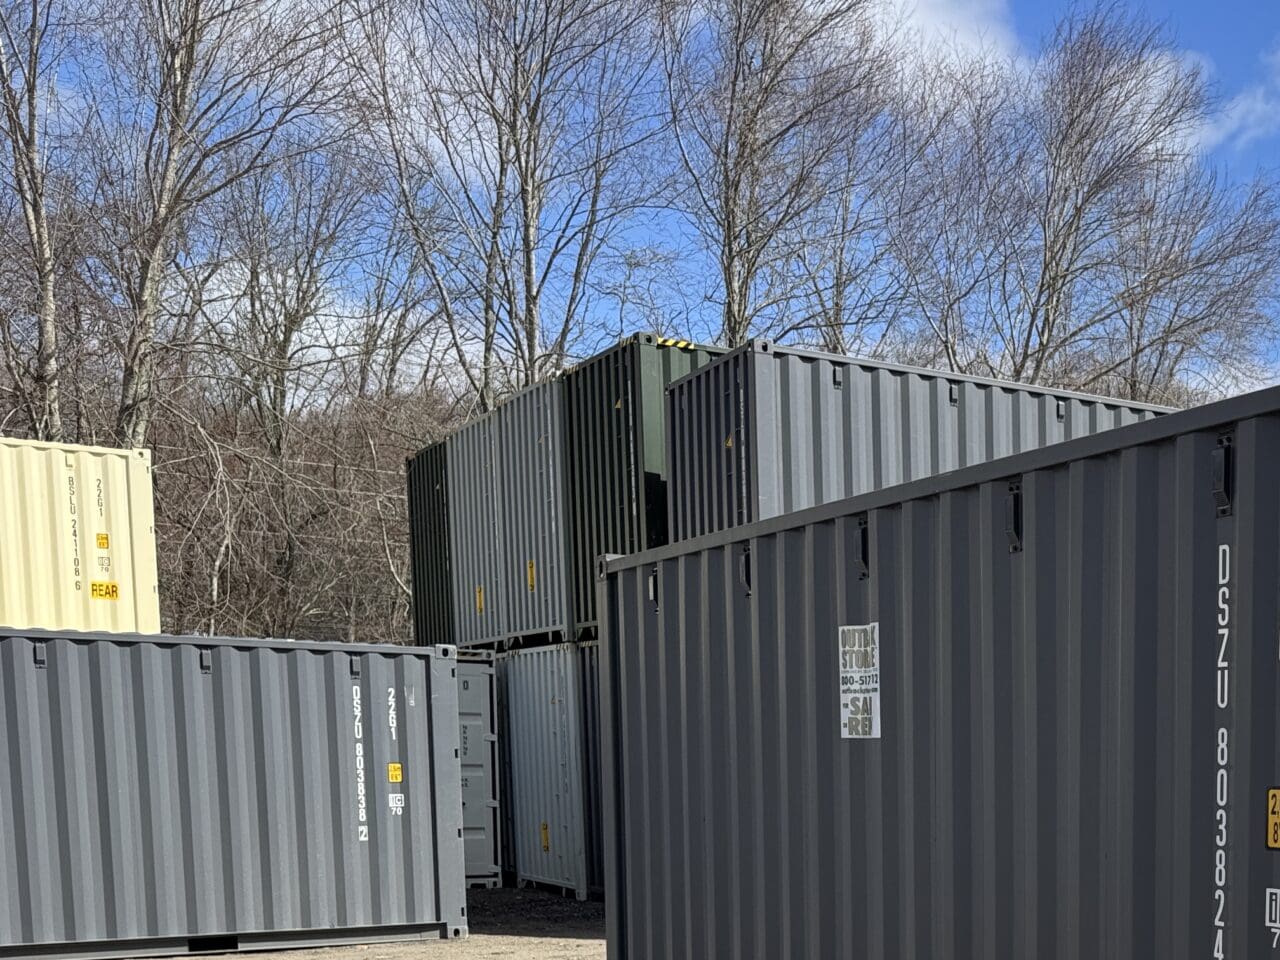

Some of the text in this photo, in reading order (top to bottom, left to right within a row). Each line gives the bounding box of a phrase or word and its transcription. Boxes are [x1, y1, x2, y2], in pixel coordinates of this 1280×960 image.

[68, 477, 76, 515] BSLU
[71, 519, 80, 577] 241108
[91, 583, 118, 598] REAR
[1217, 544, 1230, 708] DSZU
[388, 688, 396, 740] 22G1
[352, 685, 368, 841] DSZU 803838 2
[391, 807, 403, 815] 70
